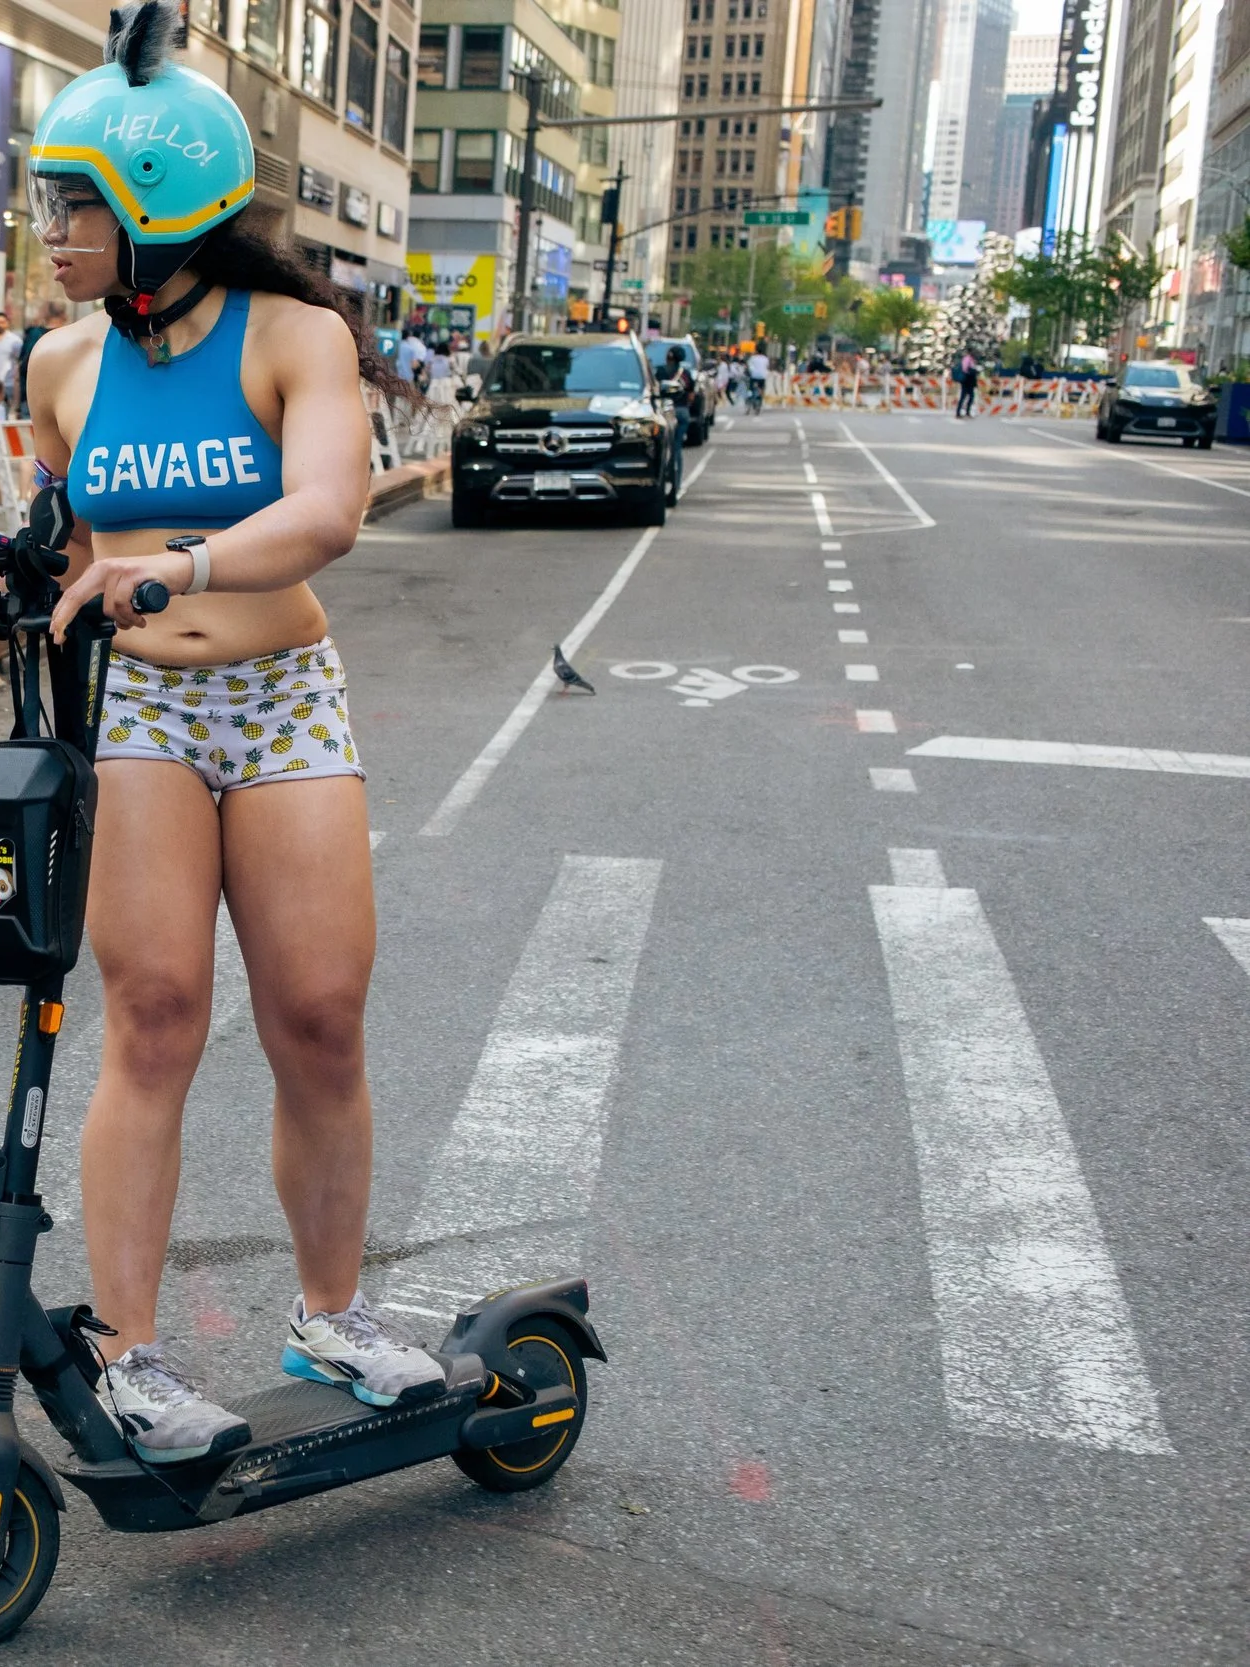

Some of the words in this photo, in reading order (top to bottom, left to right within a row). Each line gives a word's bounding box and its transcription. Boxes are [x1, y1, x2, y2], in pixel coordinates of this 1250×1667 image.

[1070, 70, 1100, 126] Foot
[103, 113, 220, 168] HELLO!
[455, 274, 478, 288] CO
[85, 436, 262, 496] SAVAGE
[31, 1094, 40, 1128] SEGWAY
